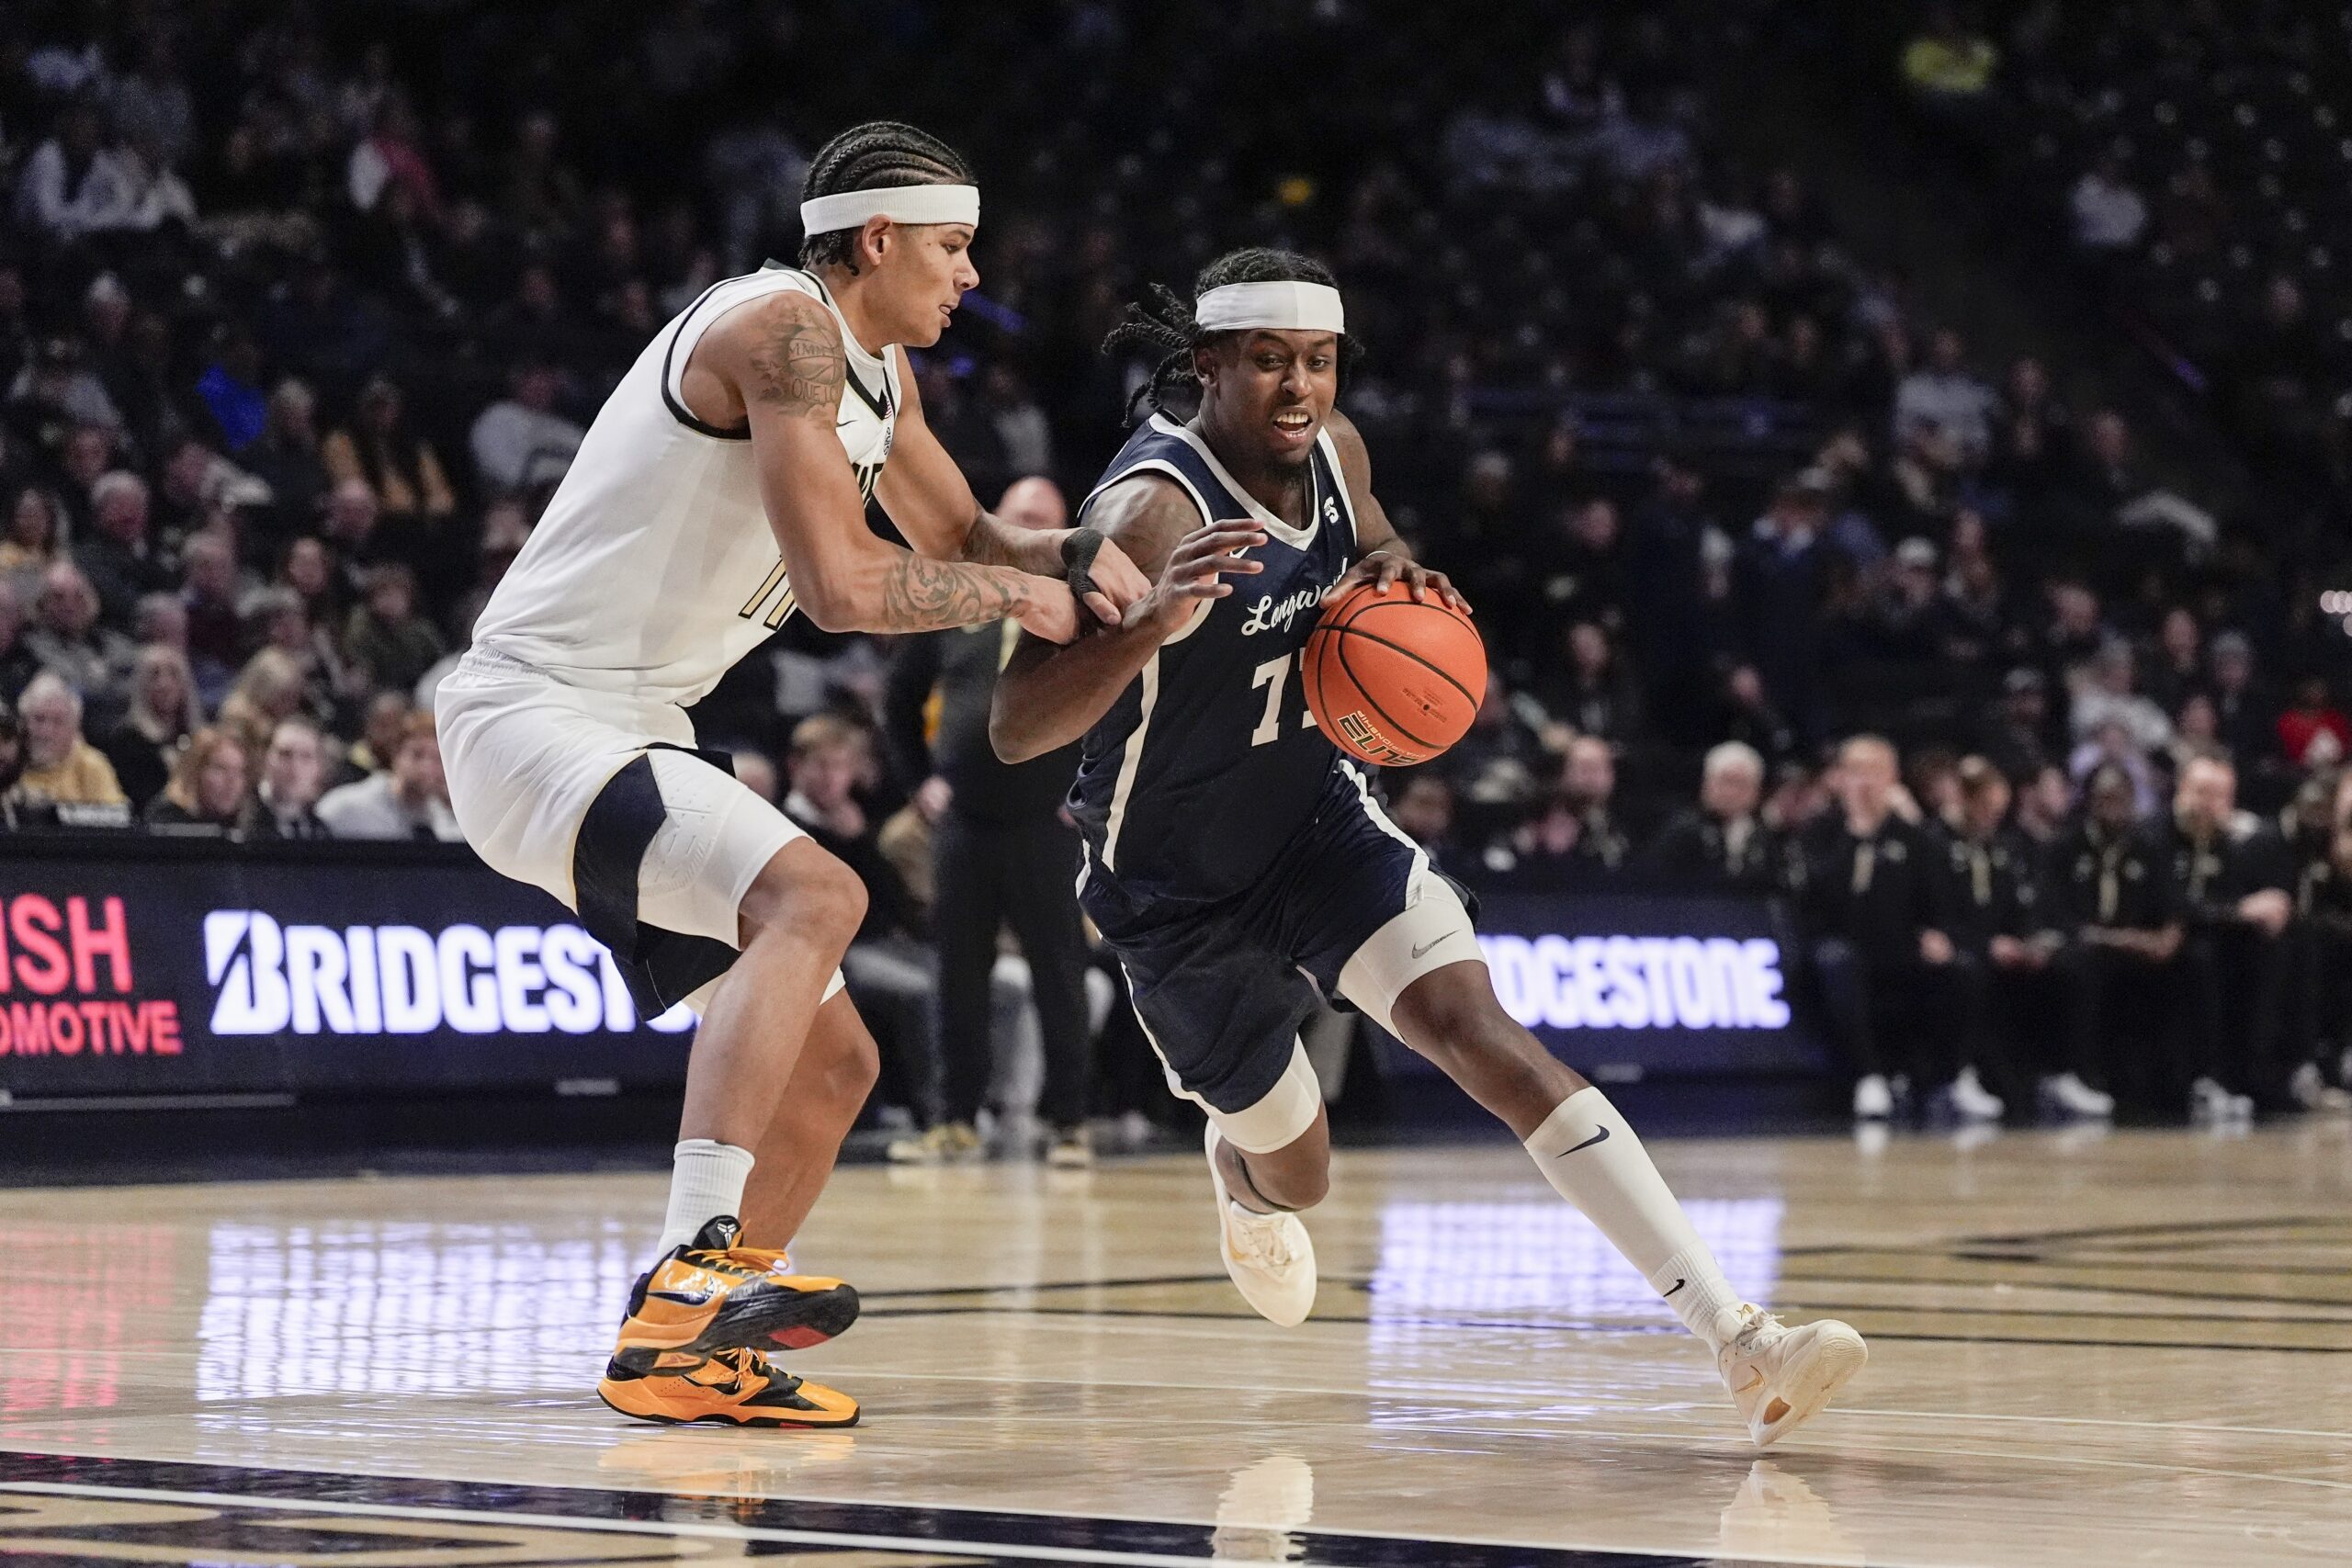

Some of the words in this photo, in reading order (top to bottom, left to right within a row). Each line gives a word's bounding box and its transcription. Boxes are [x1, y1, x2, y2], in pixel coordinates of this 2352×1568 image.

[1241, 557, 1349, 637] Longw
[1251, 647, 1317, 747] 7
[203, 909, 703, 1035] BRIDGEST
